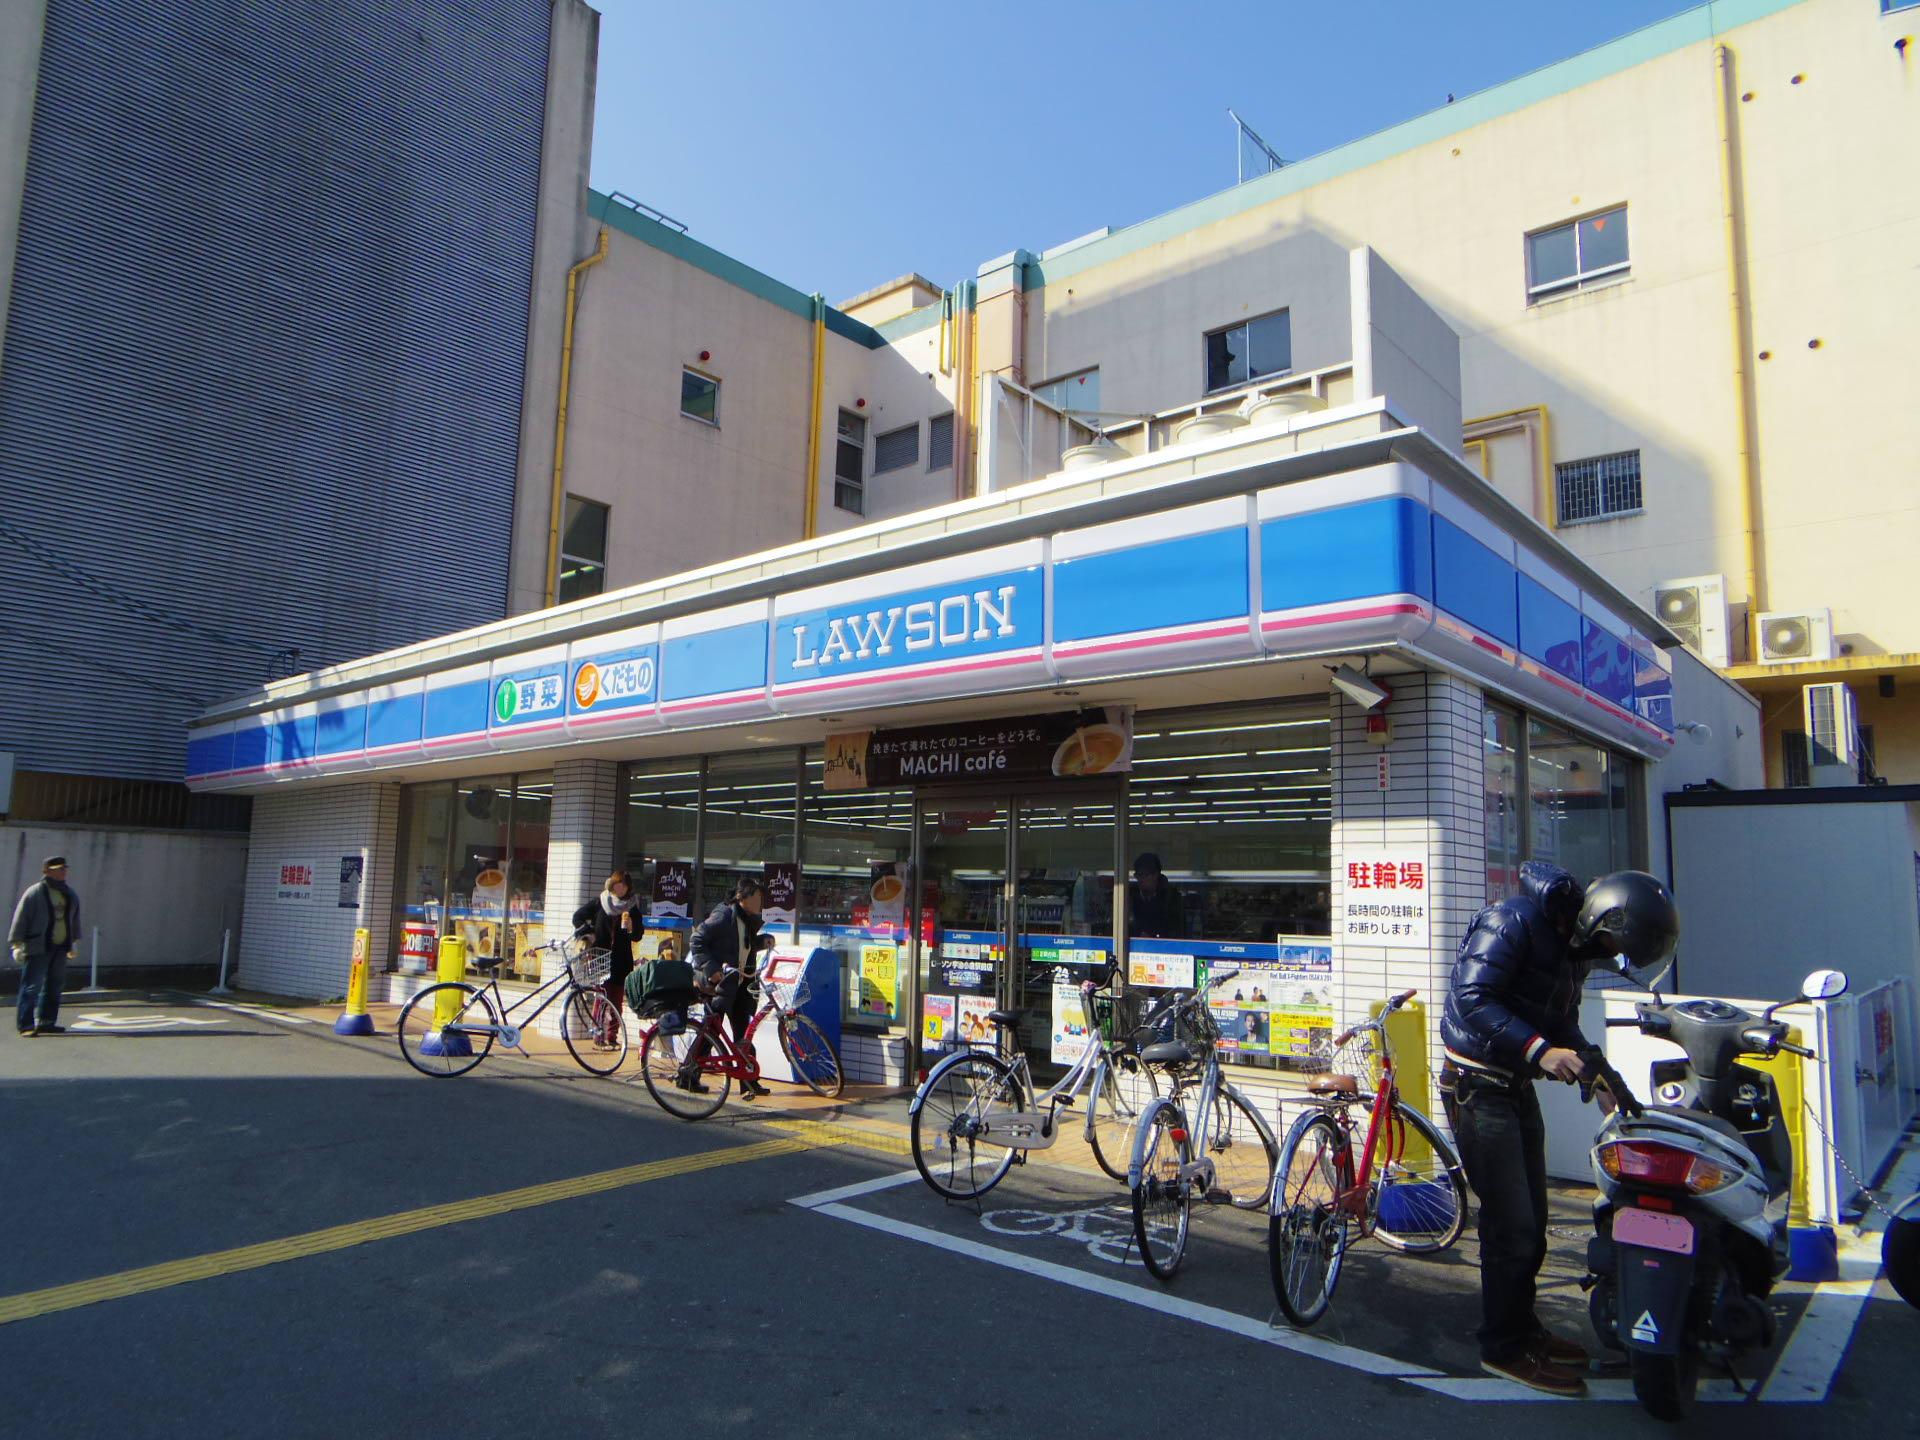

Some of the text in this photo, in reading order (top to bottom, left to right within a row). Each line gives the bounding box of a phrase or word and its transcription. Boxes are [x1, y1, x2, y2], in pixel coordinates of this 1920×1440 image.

[792, 585, 1016, 668] LAWSON
[600, 664, 652, 695] くだもの
[520, 684, 558, 710] 野菜
[900, 749, 1007, 776] MACHI café
[1347, 862, 1424, 890] 駐輪場
[1347, 904, 1424, 918] 長時間の駐輪は
[1347, 922, 1419, 936] お断りします。
